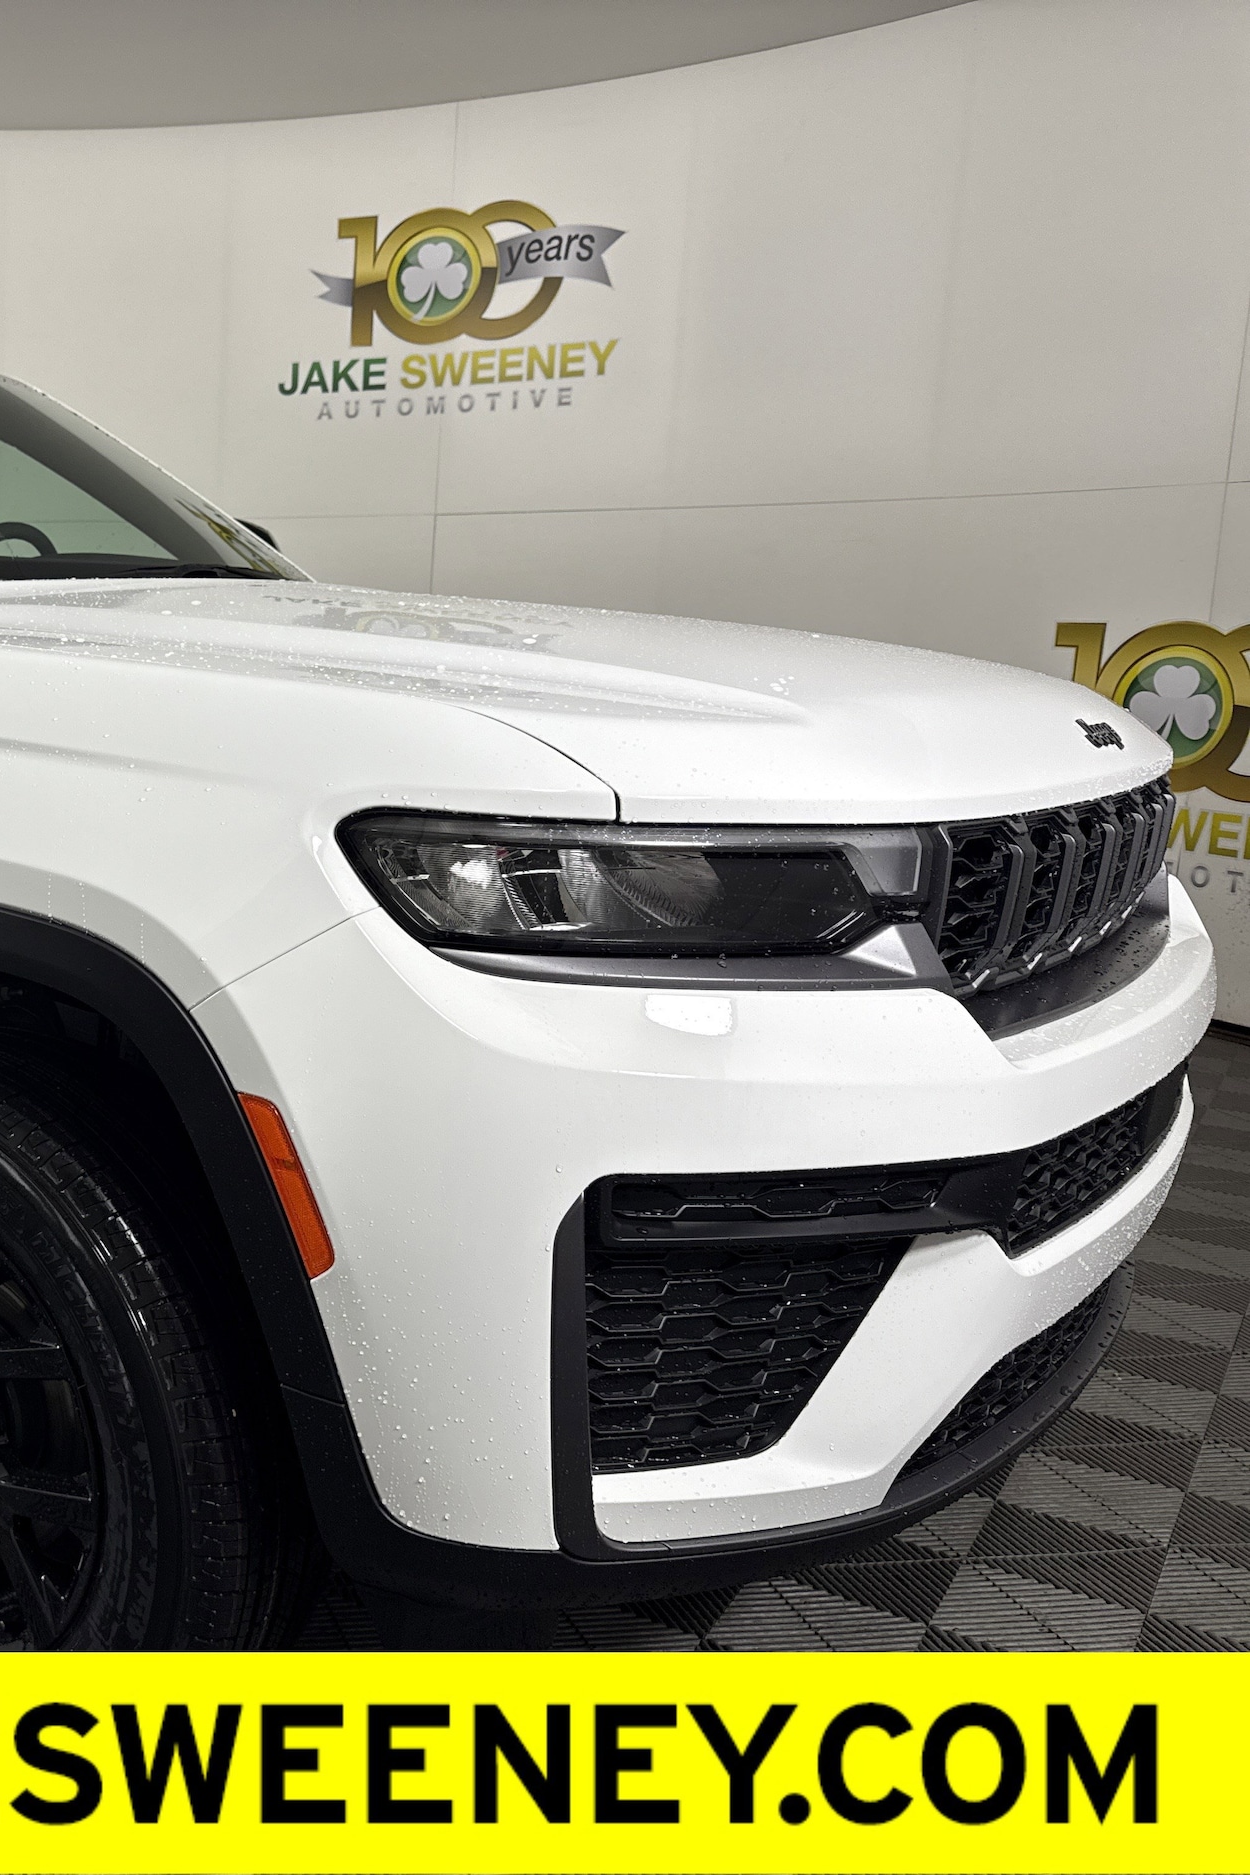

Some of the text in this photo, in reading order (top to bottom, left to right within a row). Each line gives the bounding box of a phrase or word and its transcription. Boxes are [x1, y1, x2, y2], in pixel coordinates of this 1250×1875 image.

[504, 230, 596, 277] years
[278, 339, 619, 396] JAKE SWEENEY
[316, 387, 573, 421] AUTOMOTIVE
